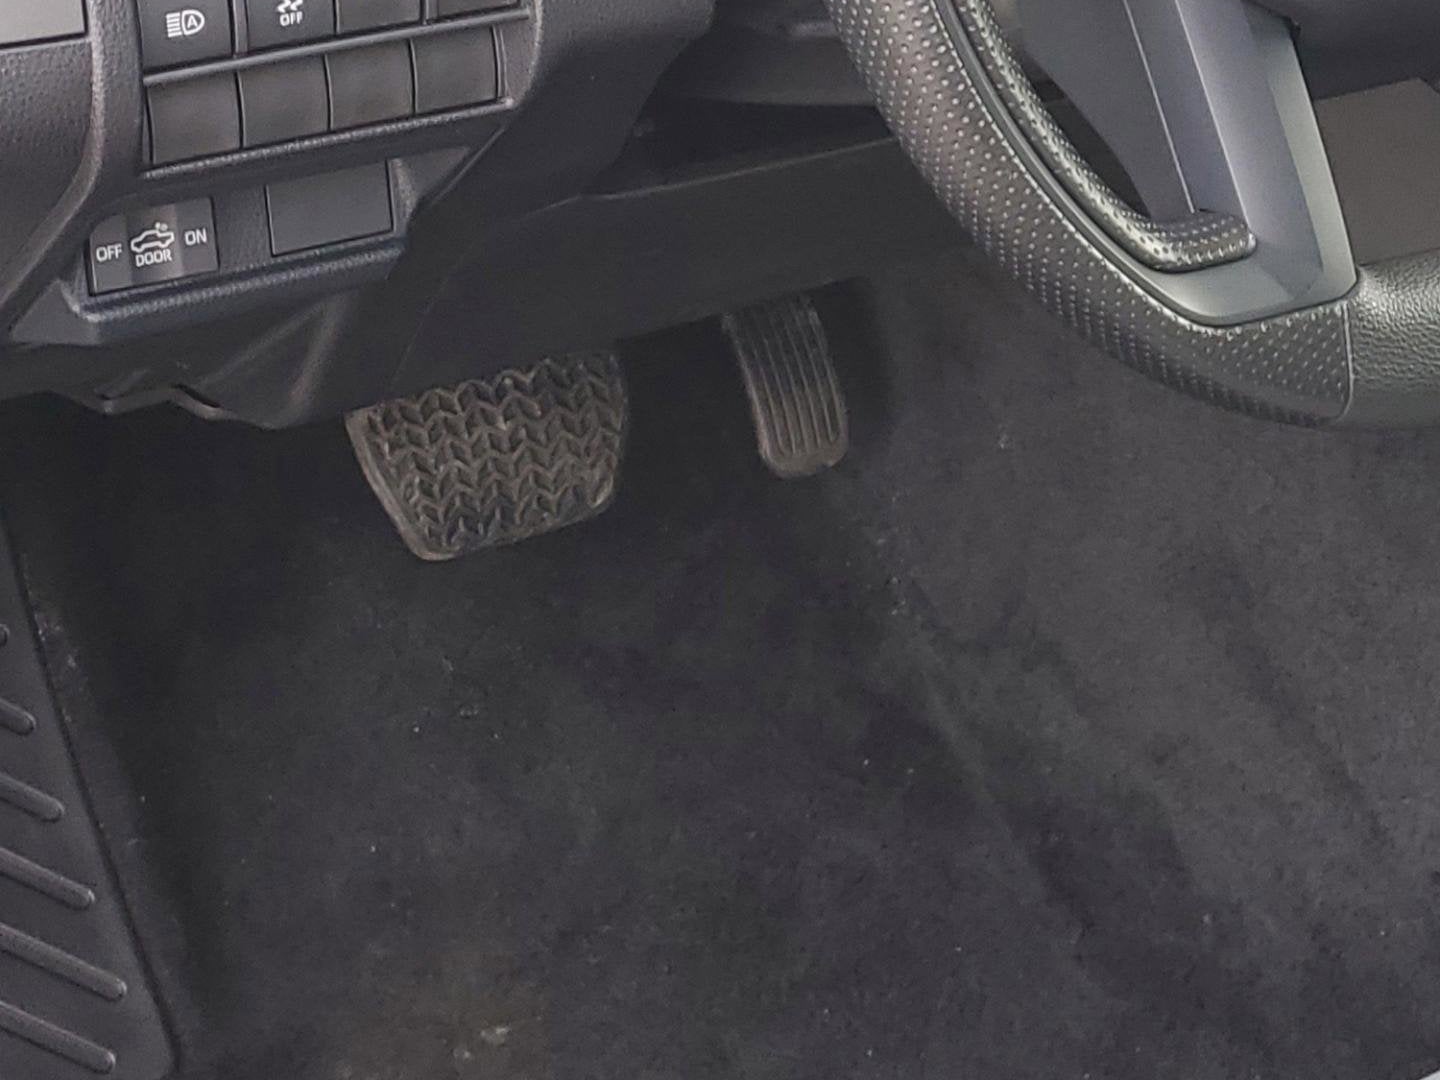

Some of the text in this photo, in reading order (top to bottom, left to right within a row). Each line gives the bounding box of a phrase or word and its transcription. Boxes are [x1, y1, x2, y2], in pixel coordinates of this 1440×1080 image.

[279, 11, 303, 27] OFF
[184, 227, 208, 246] ON
[95, 244, 123, 263] OFF
[135, 248, 173, 268] DOOR
